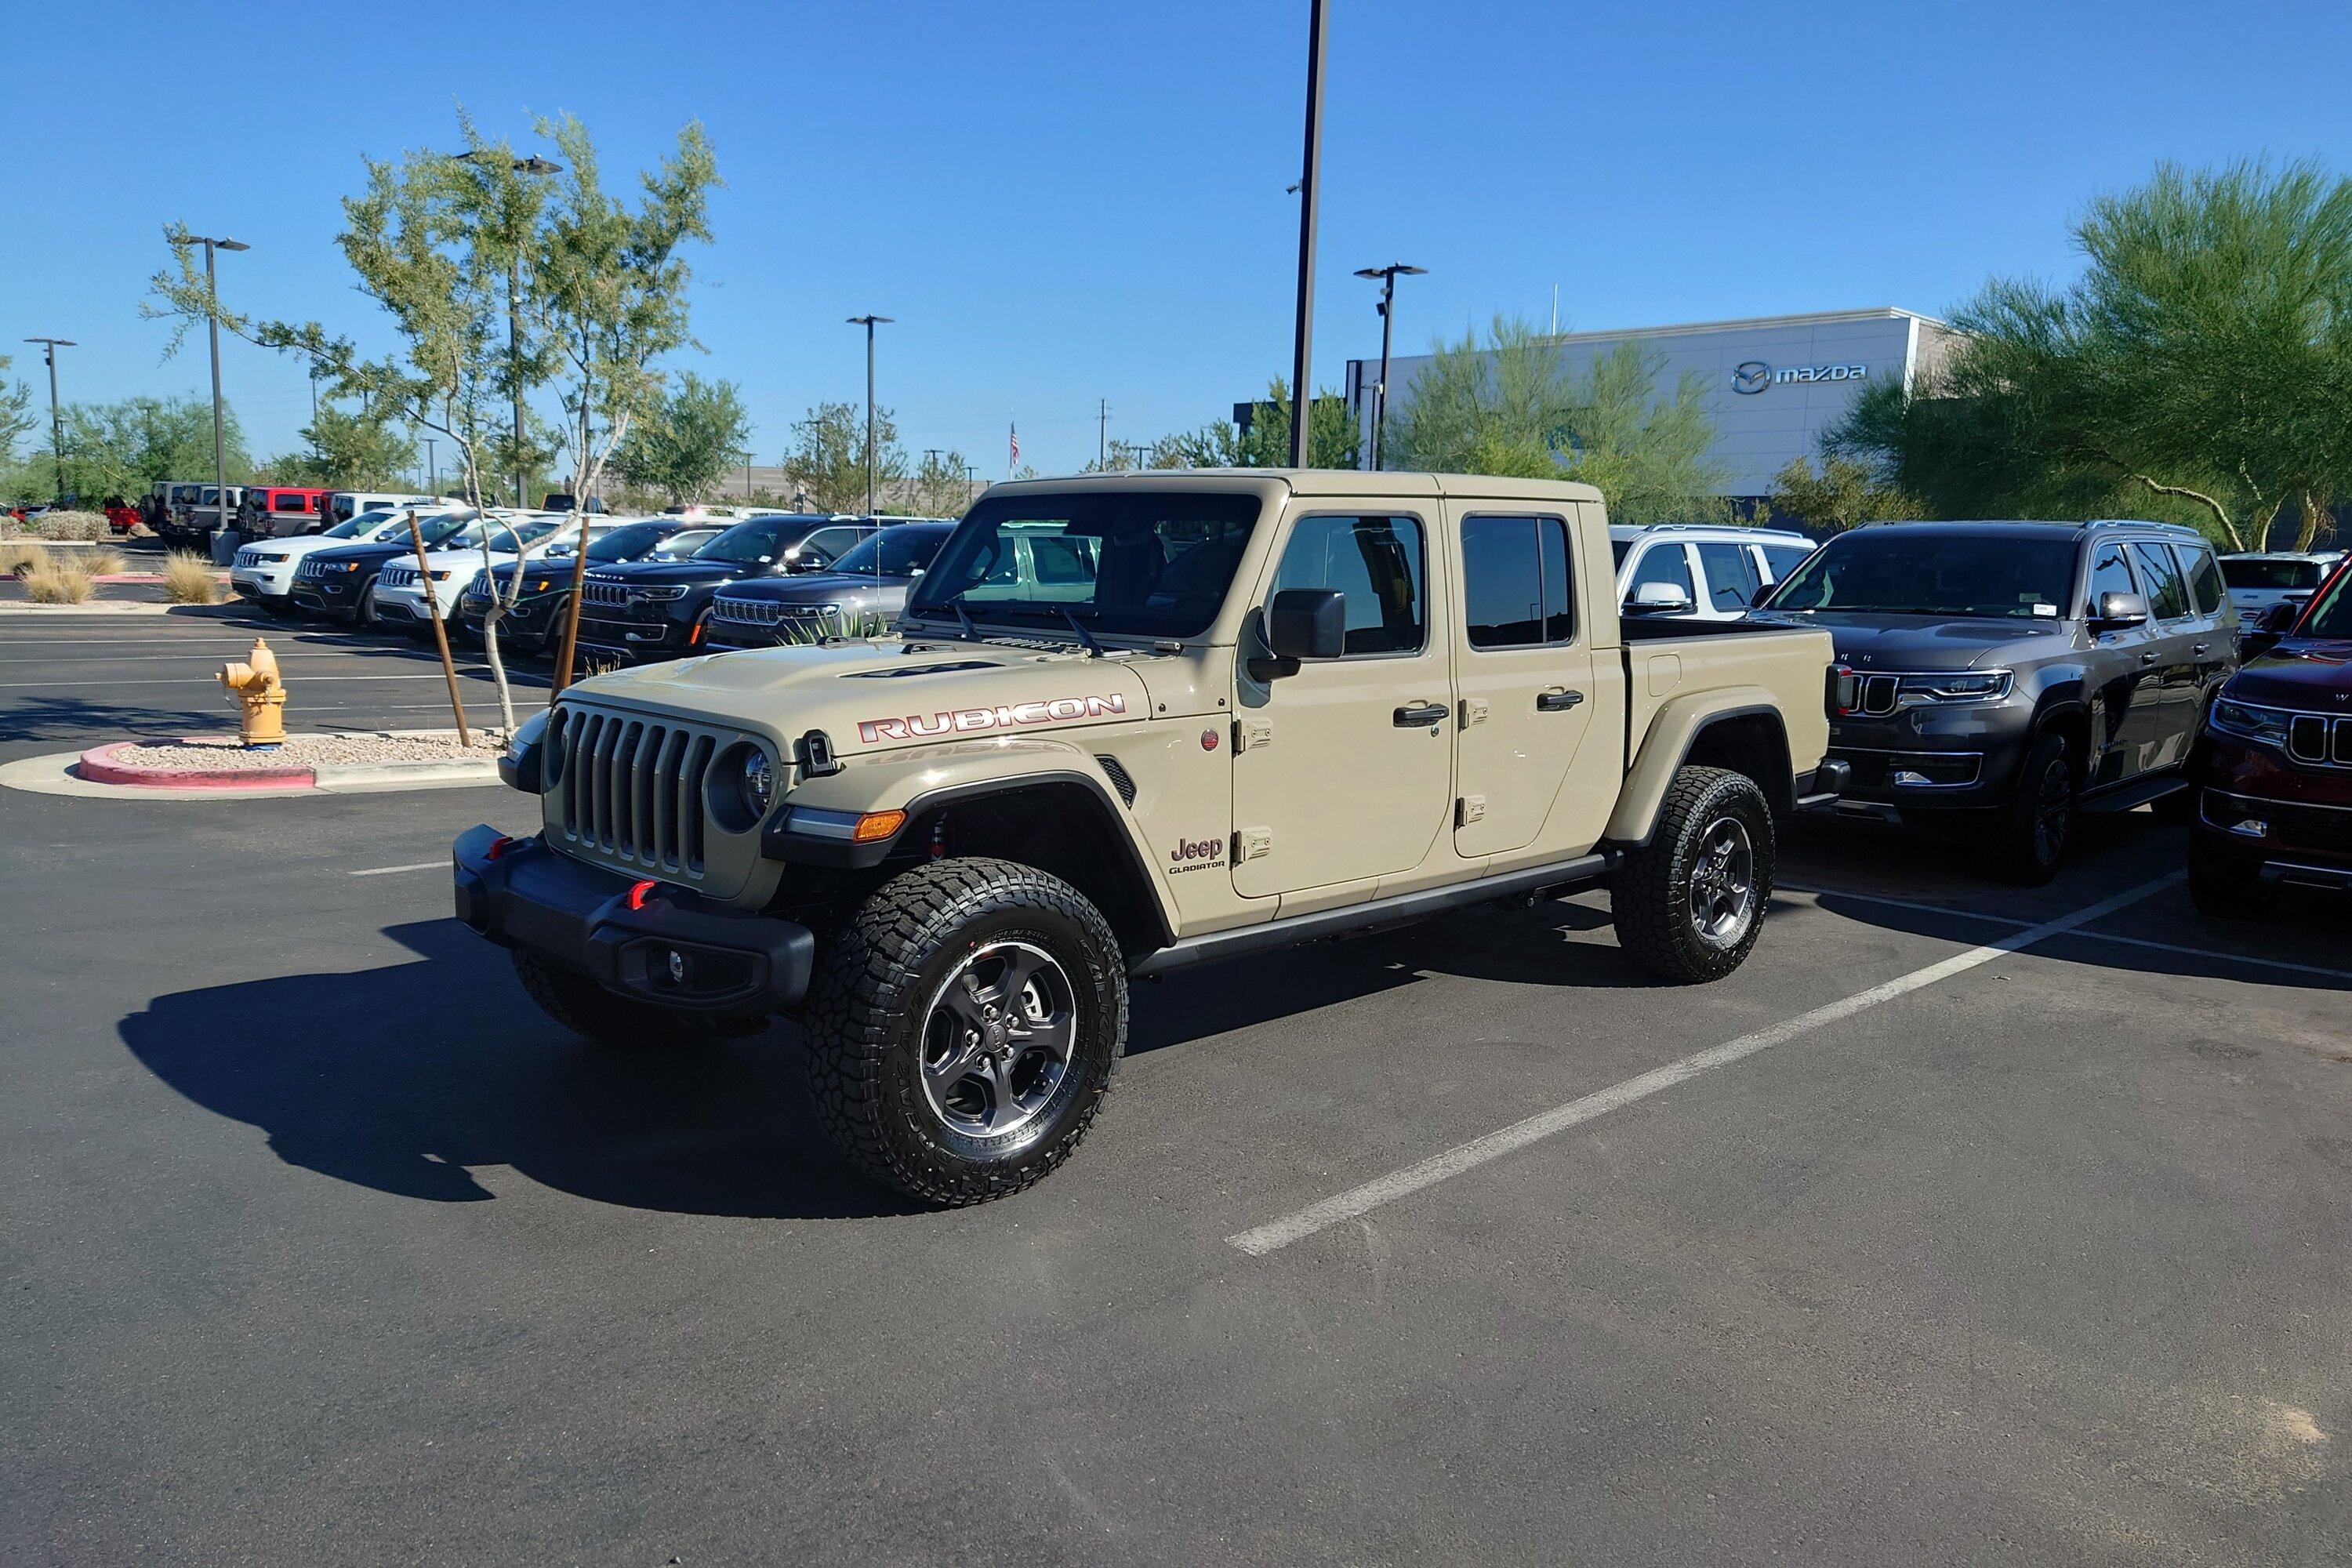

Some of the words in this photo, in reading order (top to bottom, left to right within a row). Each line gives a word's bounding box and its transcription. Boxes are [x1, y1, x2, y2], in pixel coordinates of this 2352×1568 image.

[857, 693, 1126, 743] RUBICON
[1171, 837, 1222, 861] Jeep
[1169, 861, 1225, 874] GLADIATOR
